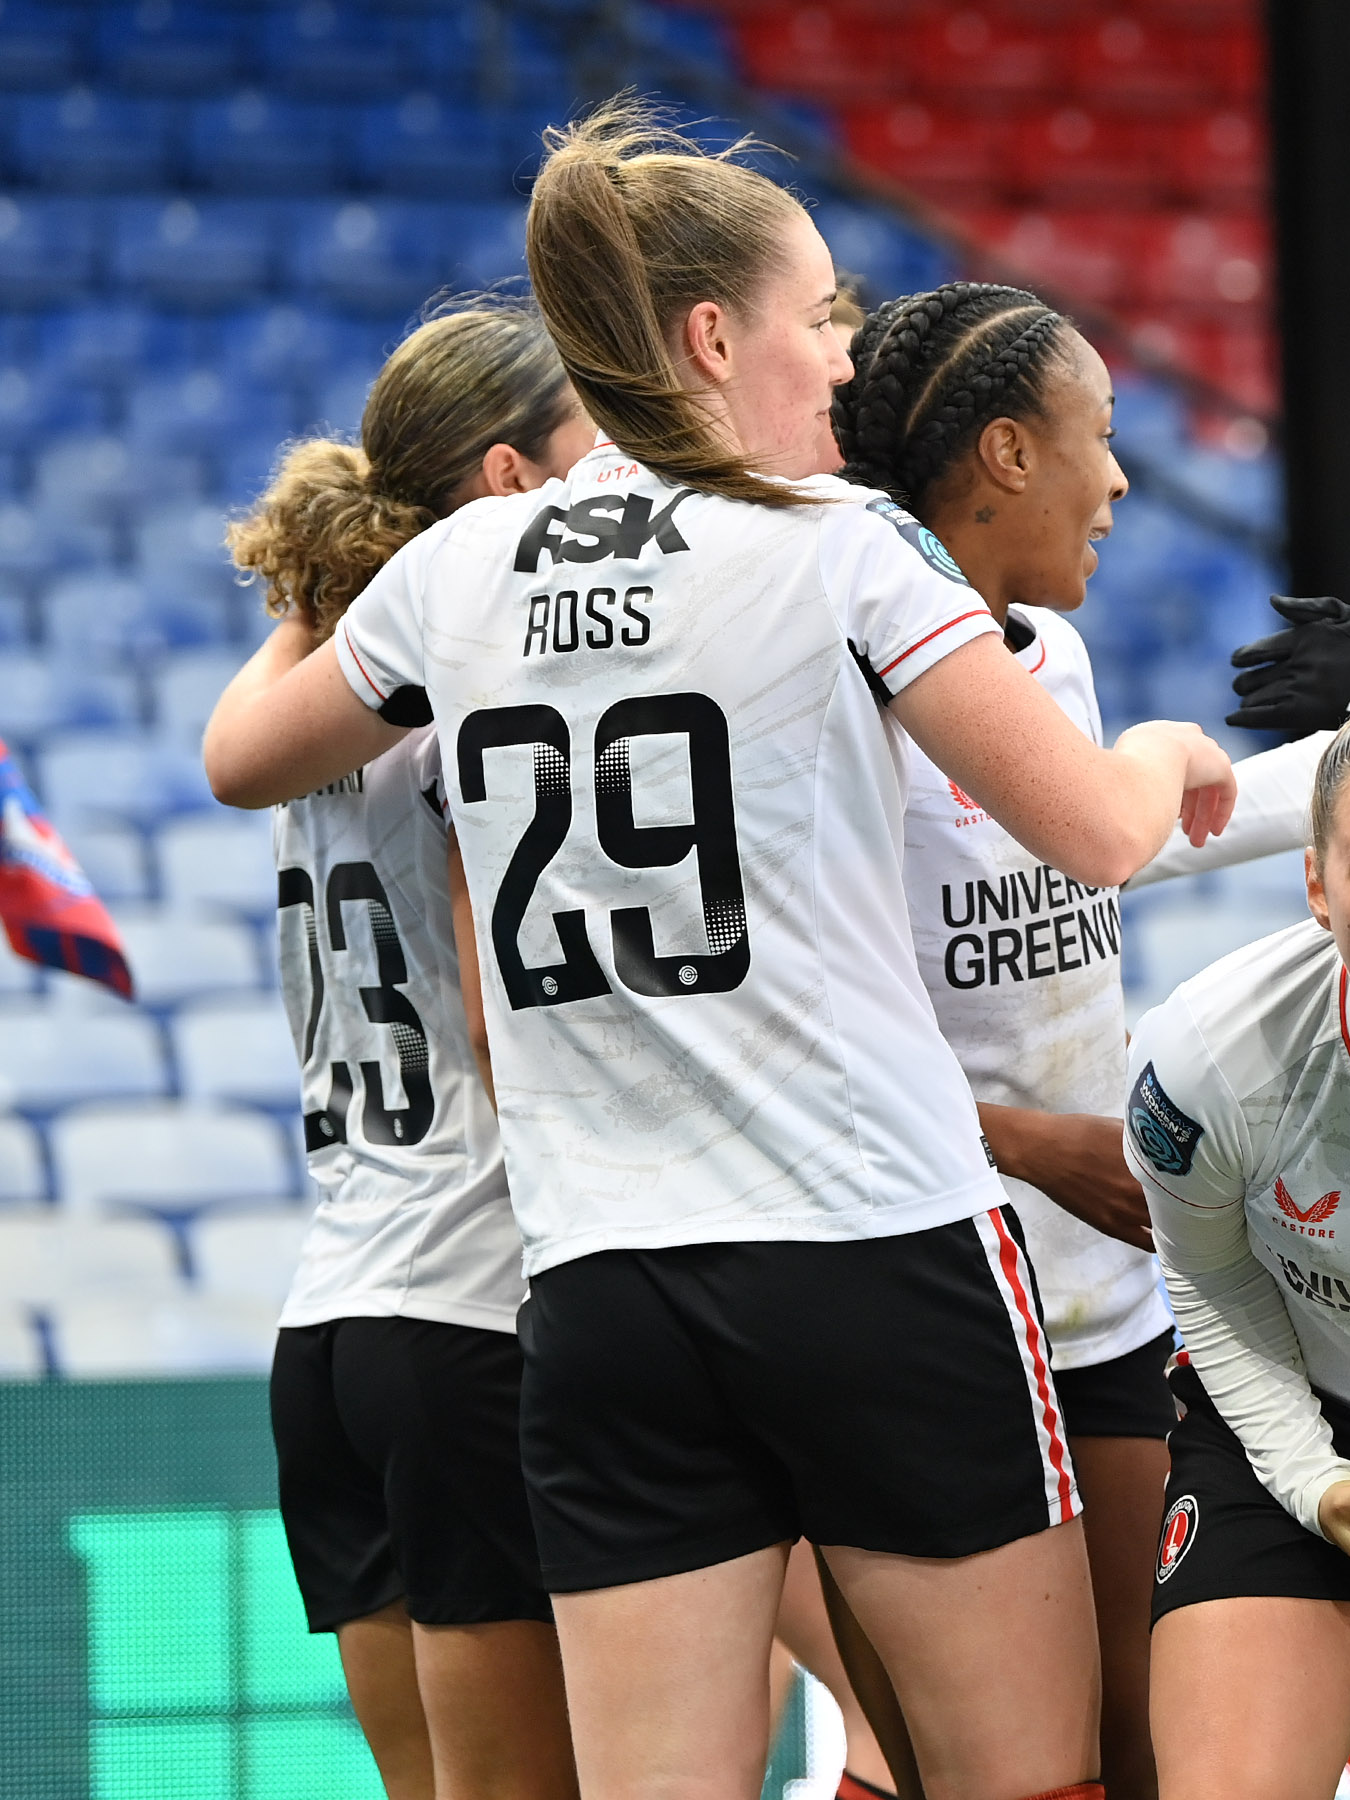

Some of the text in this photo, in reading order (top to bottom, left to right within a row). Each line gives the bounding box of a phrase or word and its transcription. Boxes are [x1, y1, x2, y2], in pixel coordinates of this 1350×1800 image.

[596, 463, 640, 483] UTA
[522, 585, 654, 658] ROSS
[456, 691, 752, 1012] 29
[944, 896, 1122, 990] GREENW
[278, 861, 436, 1153] 23
[1271, 1216, 1336, 1240] CASTORE
